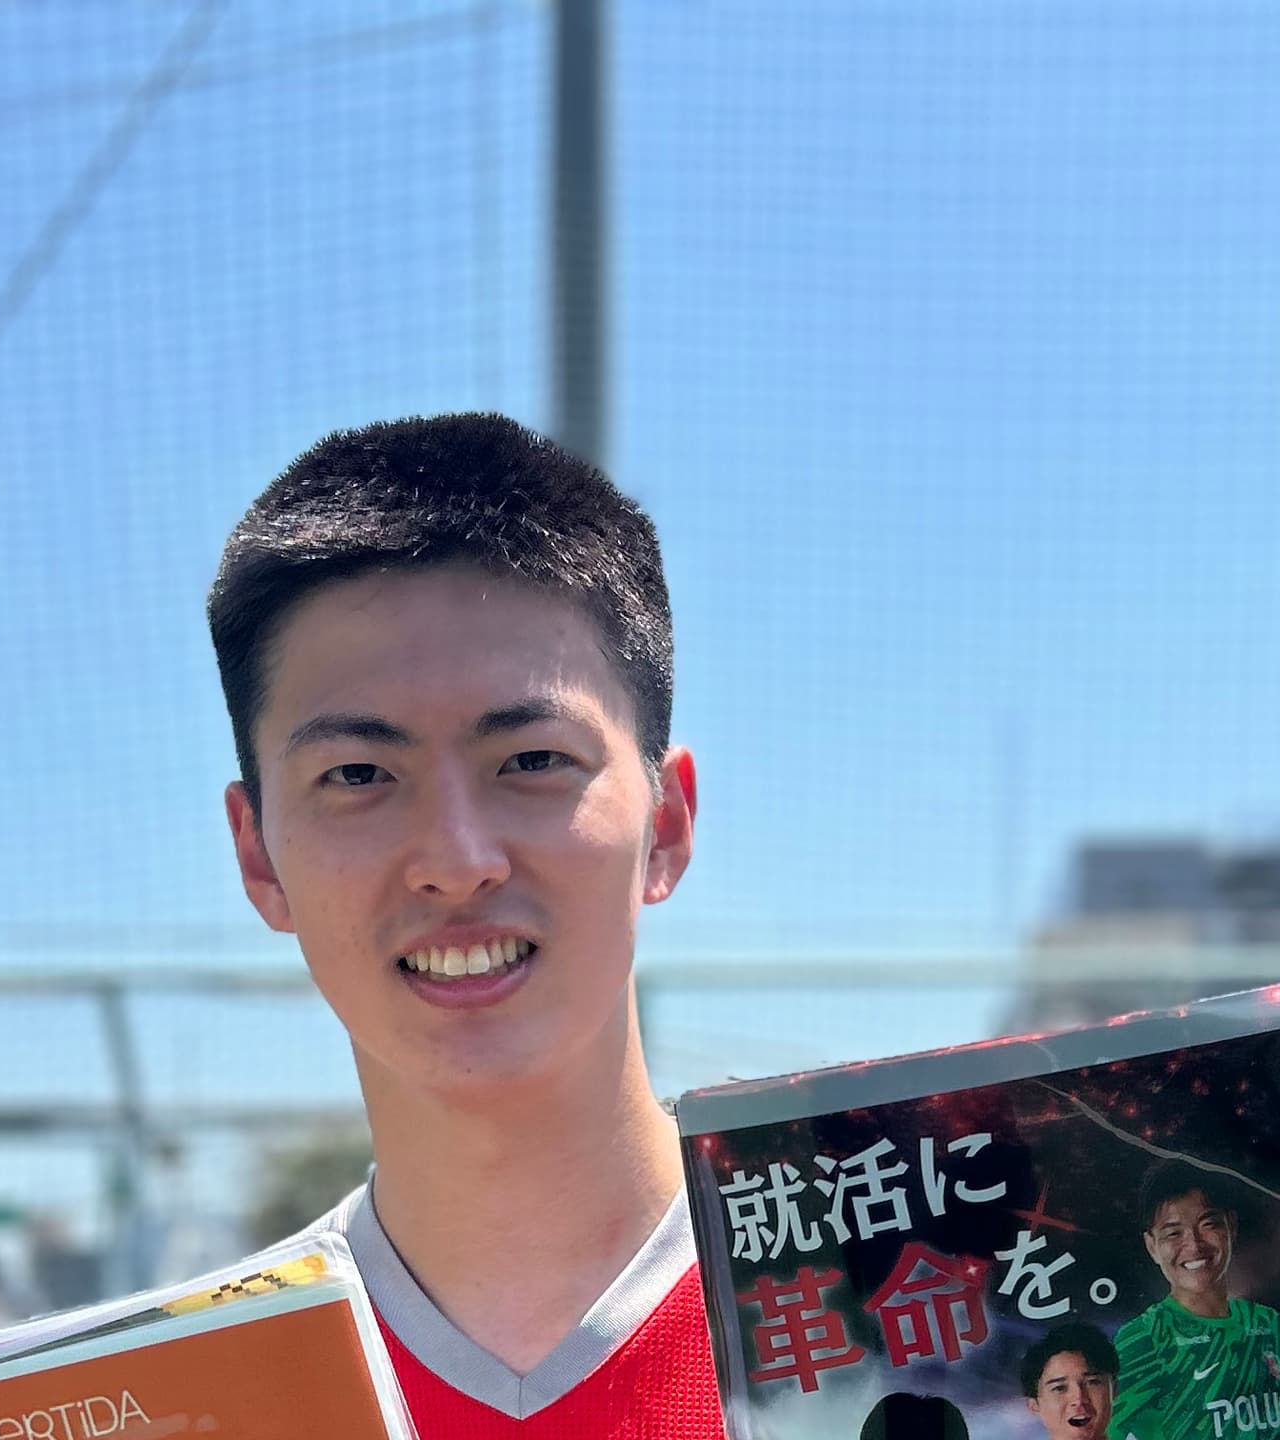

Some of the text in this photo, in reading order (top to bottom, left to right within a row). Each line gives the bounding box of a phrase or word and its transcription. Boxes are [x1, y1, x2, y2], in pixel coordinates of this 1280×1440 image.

[718, 1131, 1008, 1264] 就活に
[736, 1229, 1118, 1394] 革命を。
